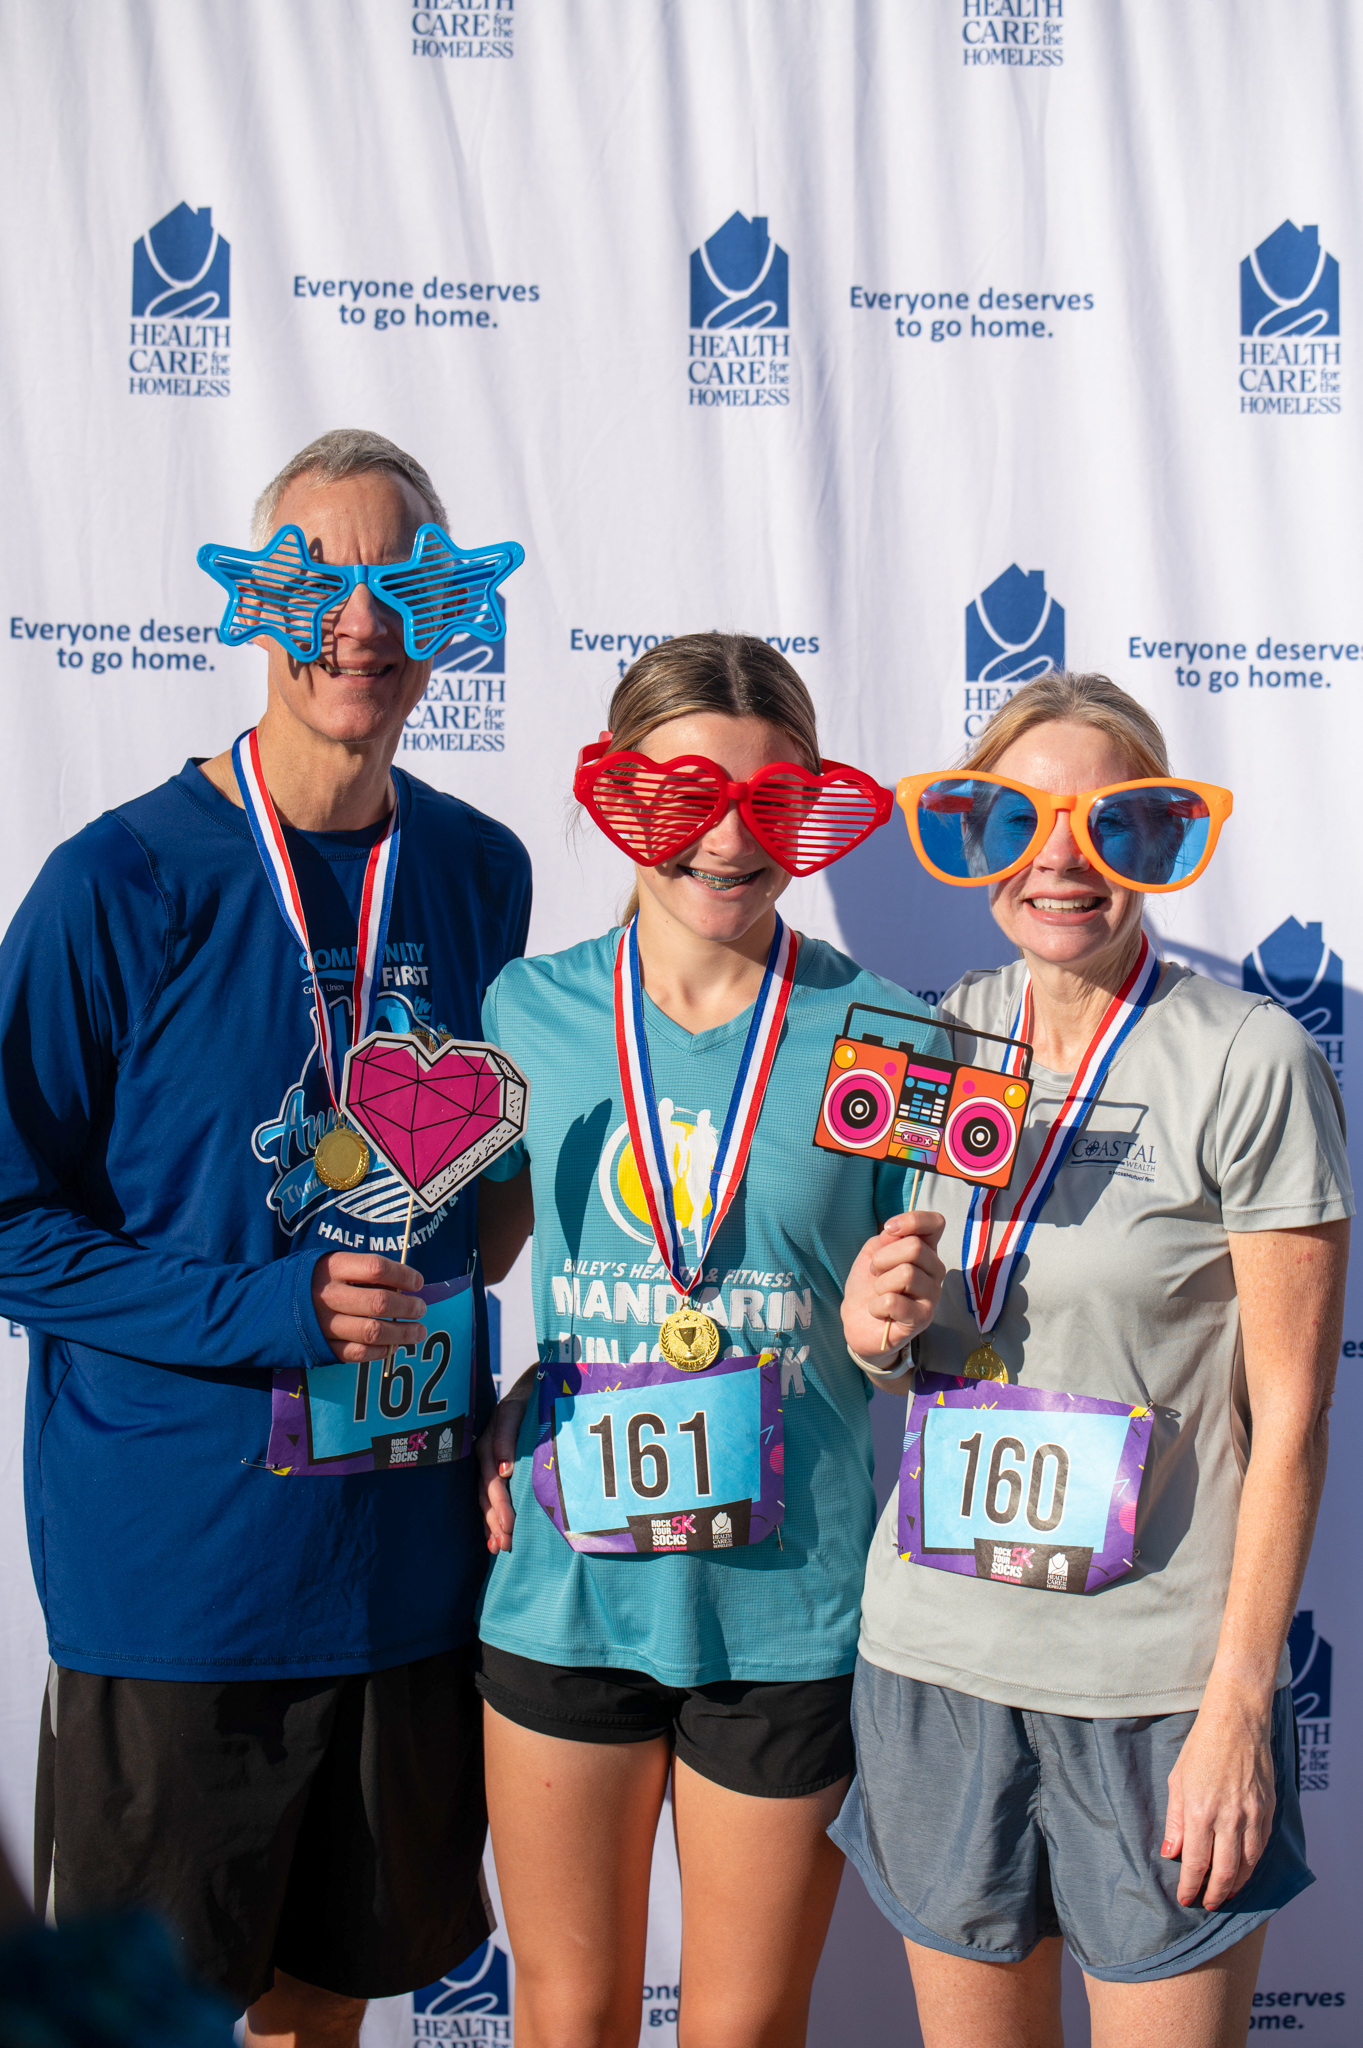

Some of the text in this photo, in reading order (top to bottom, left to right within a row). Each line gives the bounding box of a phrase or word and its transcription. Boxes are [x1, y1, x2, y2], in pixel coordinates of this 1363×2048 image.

[962, 0, 1064, 18] HEALTH
[412, 12, 513, 38] CARE for the
[962, 20, 1063, 45] CARE for the
[412, 39, 514, 58] HOMELESS
[963, 48, 1064, 67] HOMELESS
[293, 275, 541, 302] Everyone deserves
[850, 286, 1094, 316] Everyone deserves
[339, 303, 499, 331] to go home.
[895, 314, 1053, 342] to go home.
[129, 323, 231, 348] HEALTH
[688, 335, 790, 358] HEALTH
[129, 349, 230, 376] CARE for the
[1239, 343, 1341, 366] HEALTH
[688, 360, 790, 386] CARE for the
[1239, 368, 1340, 393] CARE for the
[129, 377, 231, 398] HOMELESS
[688, 388, 790, 407] HOMELESS
[1240, 397, 1341, 415] HOMELESS
[10, 617, 254, 645] Everyone deser
[570, 629, 676, 657] Everyo
[1129, 637, 1247, 665] Everyone
[57, 646, 215, 674] to go home.
[421, 678, 506, 702] EALTH
[1175, 664, 1331, 693] to go home.
[485, 704, 505, 718] for
[484, 718, 505, 731] the
[402, 733, 505, 752] HOMELESS
[299, 942, 425, 971] COMNITY
[325, 982, 345, 992] Union
[382, 965, 429, 987] FIRST
[1072, 1138, 1156, 1164] COASTAL
[1126, 1161, 1156, 1172] WEALTH
[317, 1221, 365, 1249] HALF
[369, 1205, 449, 1252] MARATHON
[704, 1267, 719, 1283] &
[722, 1269, 794, 1288] FITNESS
[552, 1276, 813, 1333] MANDARIN
[353, 1330, 452, 1423] 162
[391, 1430, 429, 1451] ROCK 5K
[391, 1445, 408, 1454] YOUR
[389, 1450, 419, 1464] SOCKS
[587, 1409, 712, 1500] 161
[958, 1430, 1071, 1534] 160
[651, 1513, 697, 1535] ROCK 5K
[651, 1527, 672, 1535] YOUR
[652, 1533, 688, 1546] SOCKS
[993, 1546, 1036, 1569] ROCK 5K
[993, 1554, 1011, 1565] YOUR
[990, 1562, 1023, 1579] SOCKS
[1252, 1991, 1346, 2007] eserves
[412, 2018, 510, 2040] HEALTH
[649, 2008, 678, 2028] go
[1249, 2014, 1304, 2030] me.
